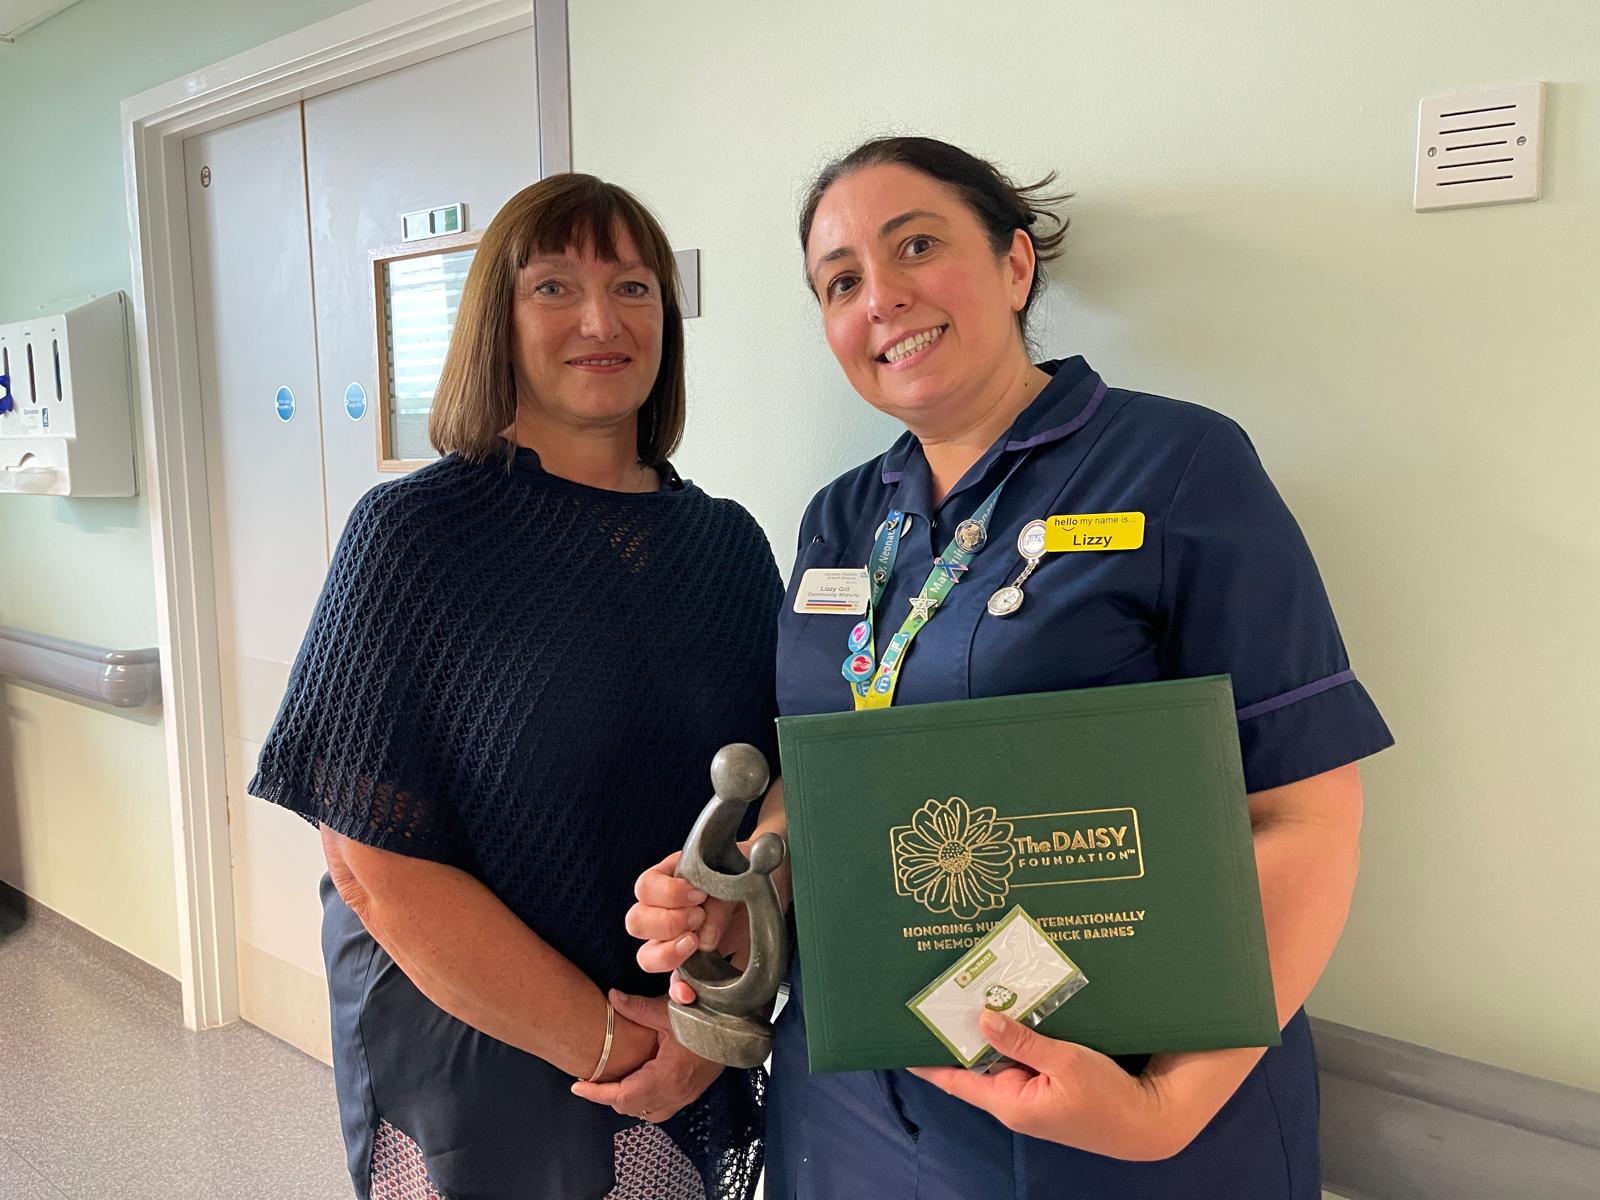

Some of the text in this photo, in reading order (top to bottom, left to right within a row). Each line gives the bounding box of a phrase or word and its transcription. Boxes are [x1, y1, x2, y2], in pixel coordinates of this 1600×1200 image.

[1054, 518, 1078, 526] hello
[1080, 518, 1093, 526] my
[1095, 516, 1119, 525] name
[1073, 534, 1112, 548] Lizzy
[1013, 826, 1128, 854] The DAISY
[903, 923, 974, 938] HONORING
[917, 940, 932, 951] IN
[1083, 926, 1135, 940] BARNES
